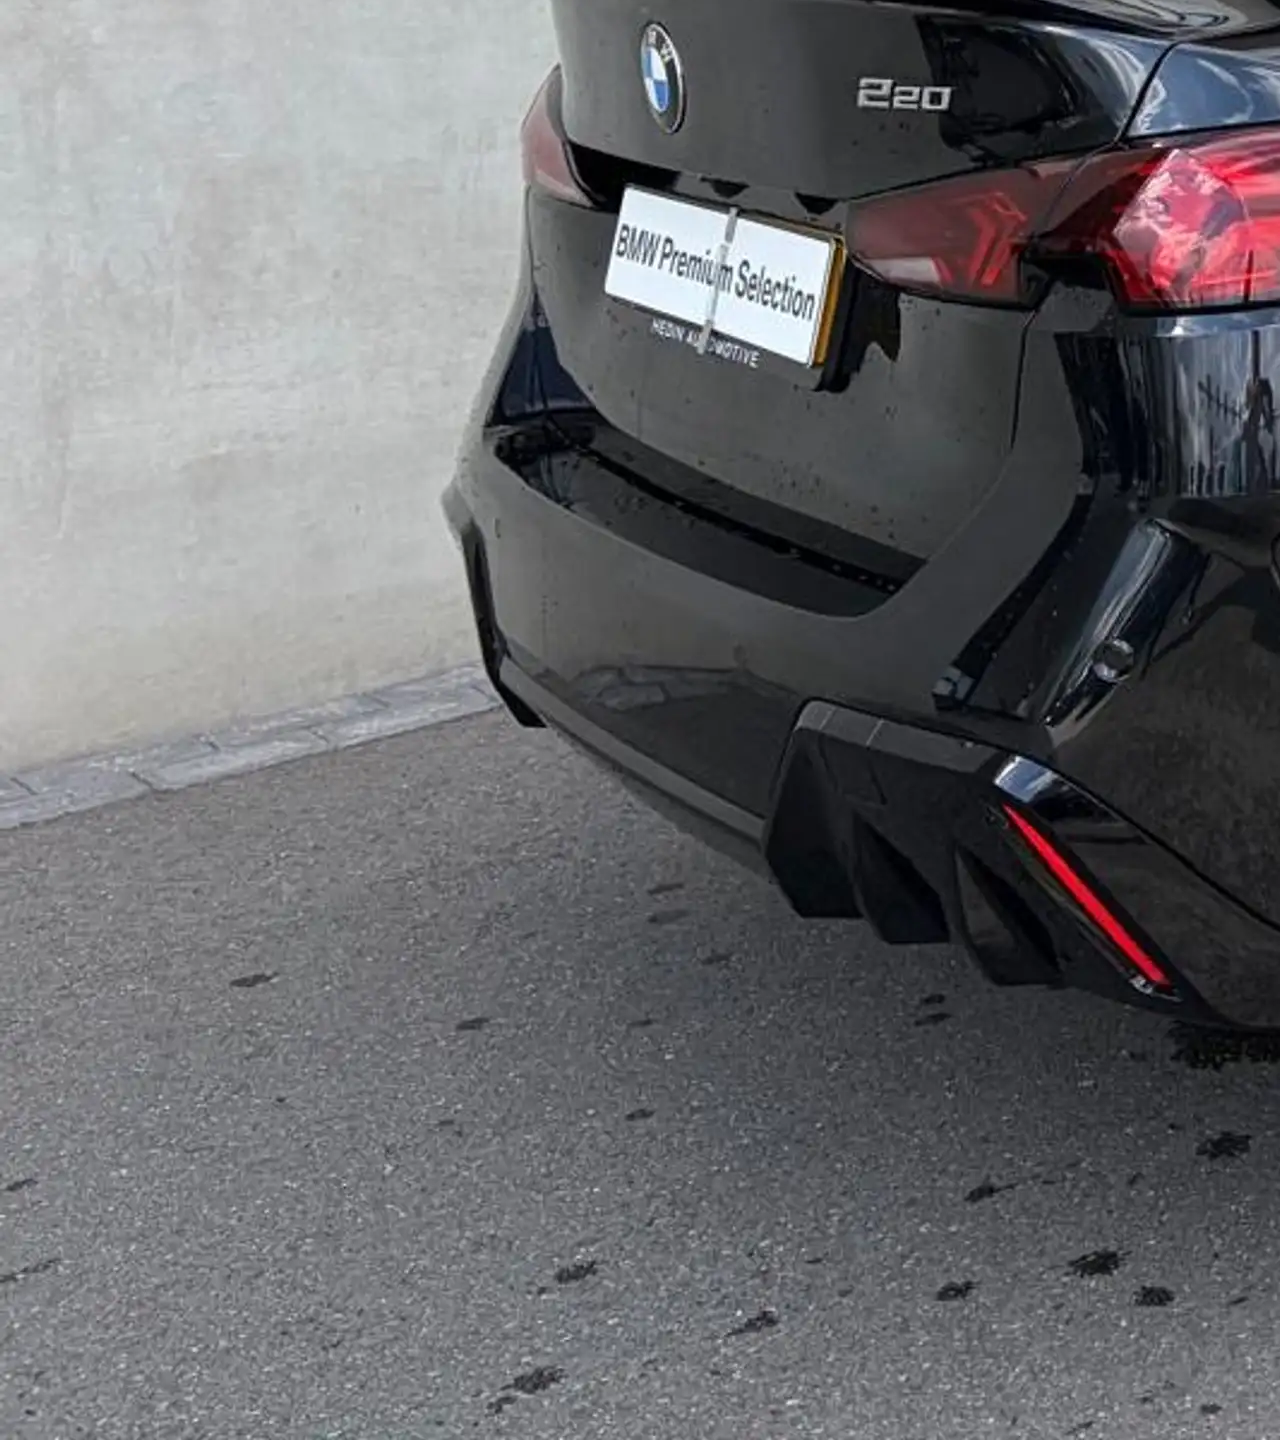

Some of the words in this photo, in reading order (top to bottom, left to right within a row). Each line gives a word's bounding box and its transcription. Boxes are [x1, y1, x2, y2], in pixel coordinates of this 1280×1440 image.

[857, 77, 952, 111] 220
[615, 223, 662, 267] BMW
[658, 235, 733, 294] Premium
[735, 260, 816, 321] Selection
[651, 318, 685, 342] HEDIN
[686, 329, 760, 369] AUOMOTIVE
